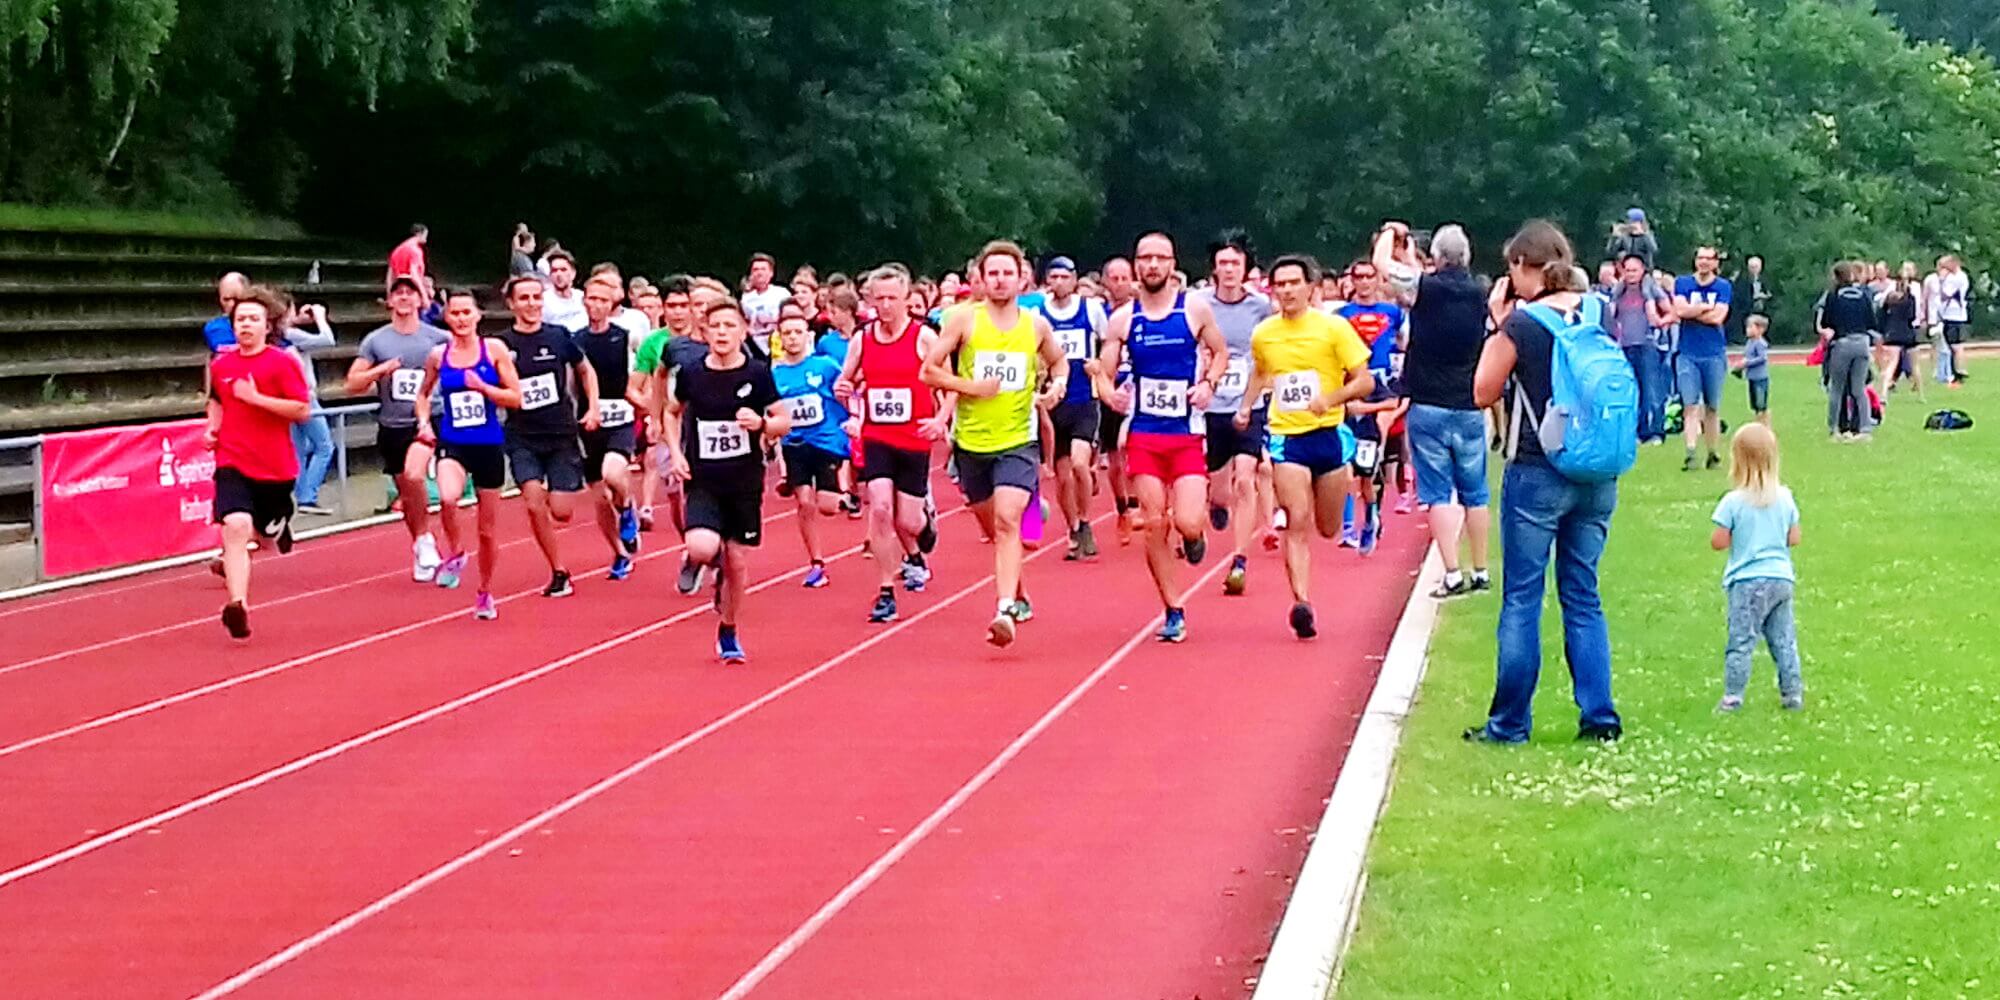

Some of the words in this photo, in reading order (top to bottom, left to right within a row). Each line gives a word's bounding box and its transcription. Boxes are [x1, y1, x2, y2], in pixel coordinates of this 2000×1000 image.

[523, 386, 551, 405] 520
[1146, 390, 1182, 411] 354
[1281, 385, 1312, 403] 489
[453, 404, 485, 421] 330
[874, 402, 905, 417] 669
[705, 434, 741, 453] 783
